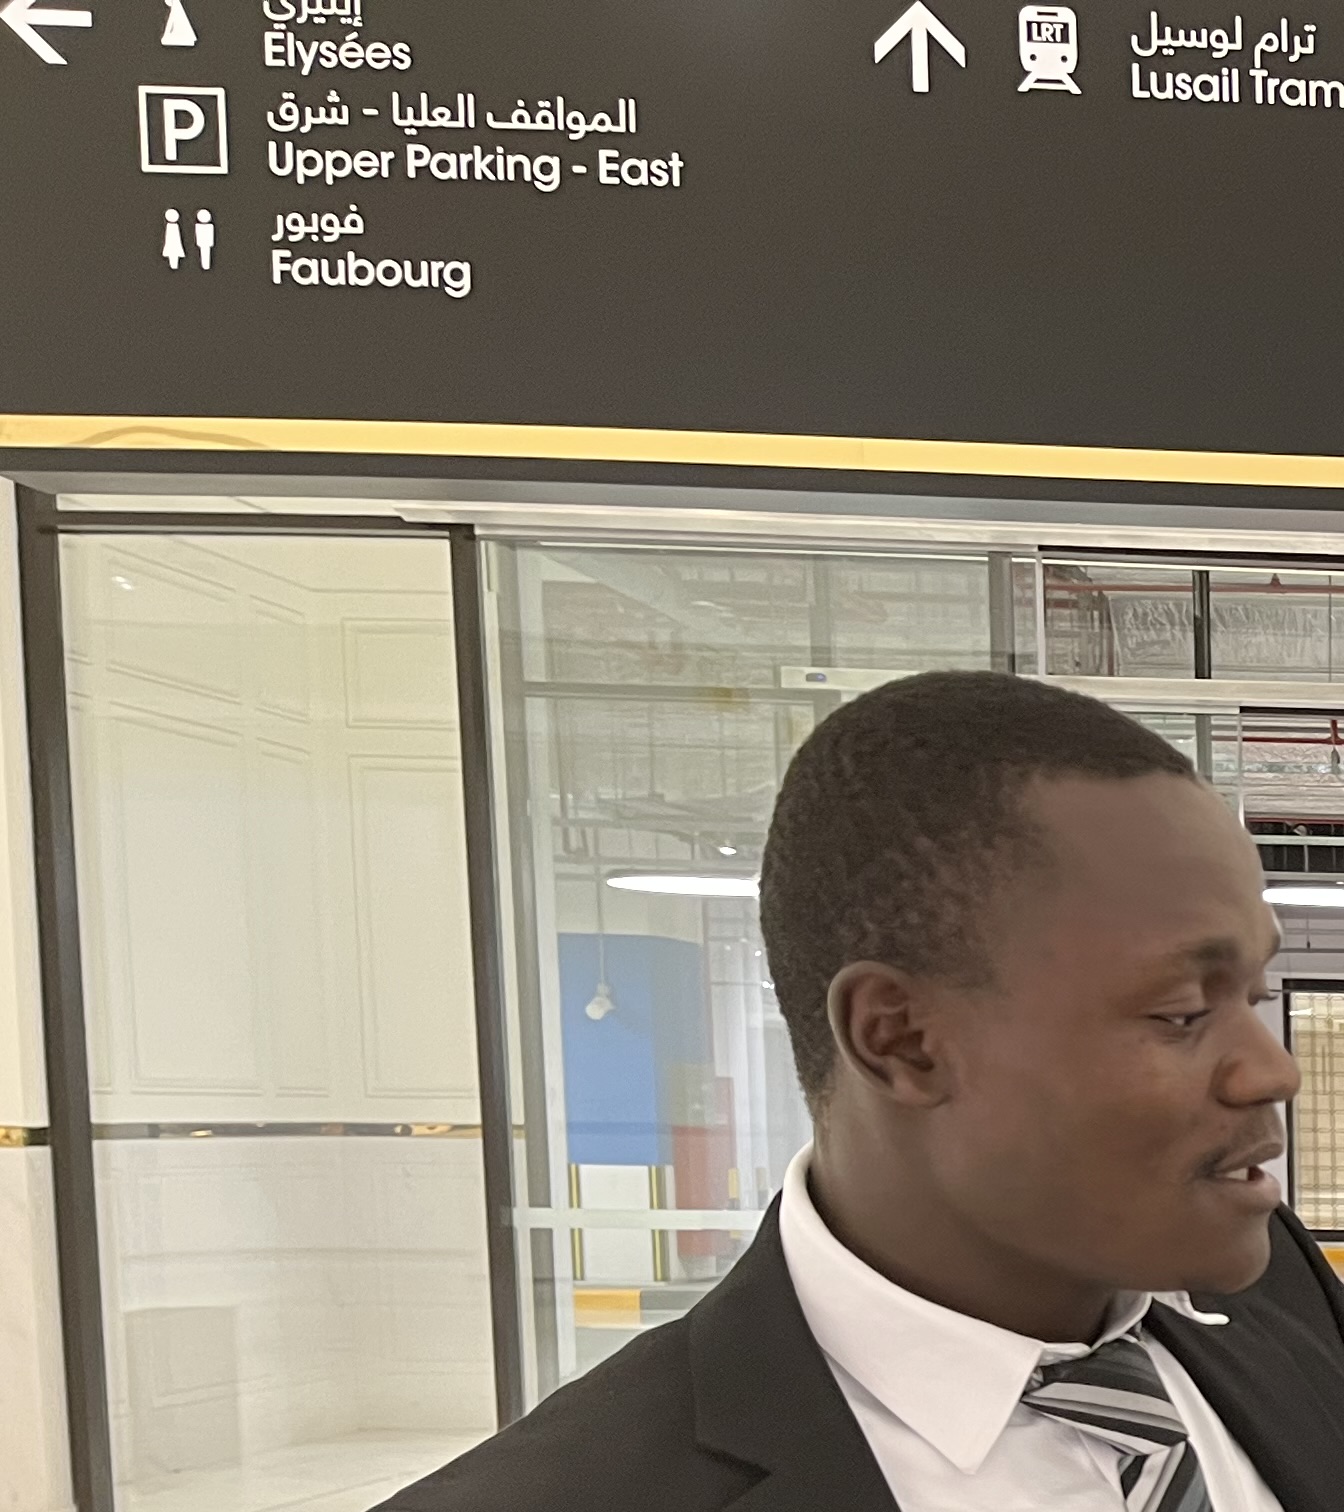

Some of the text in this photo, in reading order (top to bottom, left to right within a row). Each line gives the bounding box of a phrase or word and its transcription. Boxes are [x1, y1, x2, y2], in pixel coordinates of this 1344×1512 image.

[1031, 22, 1064, 43] LRT
[1131, 11, 1317, 69] ترام لوسيل
[1131, 63, 1240, 104] Lusail
[163, 98, 205, 161] P
[266, 90, 350, 133] شرق
[391, 91, 476, 135] العليا
[485, 96, 638, 141] المواقف
[267, 141, 395, 185] Upper
[406, 143, 561, 193] Parking
[598, 149, 685, 188] East
[271, 203, 365, 243] فوبور
[272, 248, 472, 299] Faubourg
